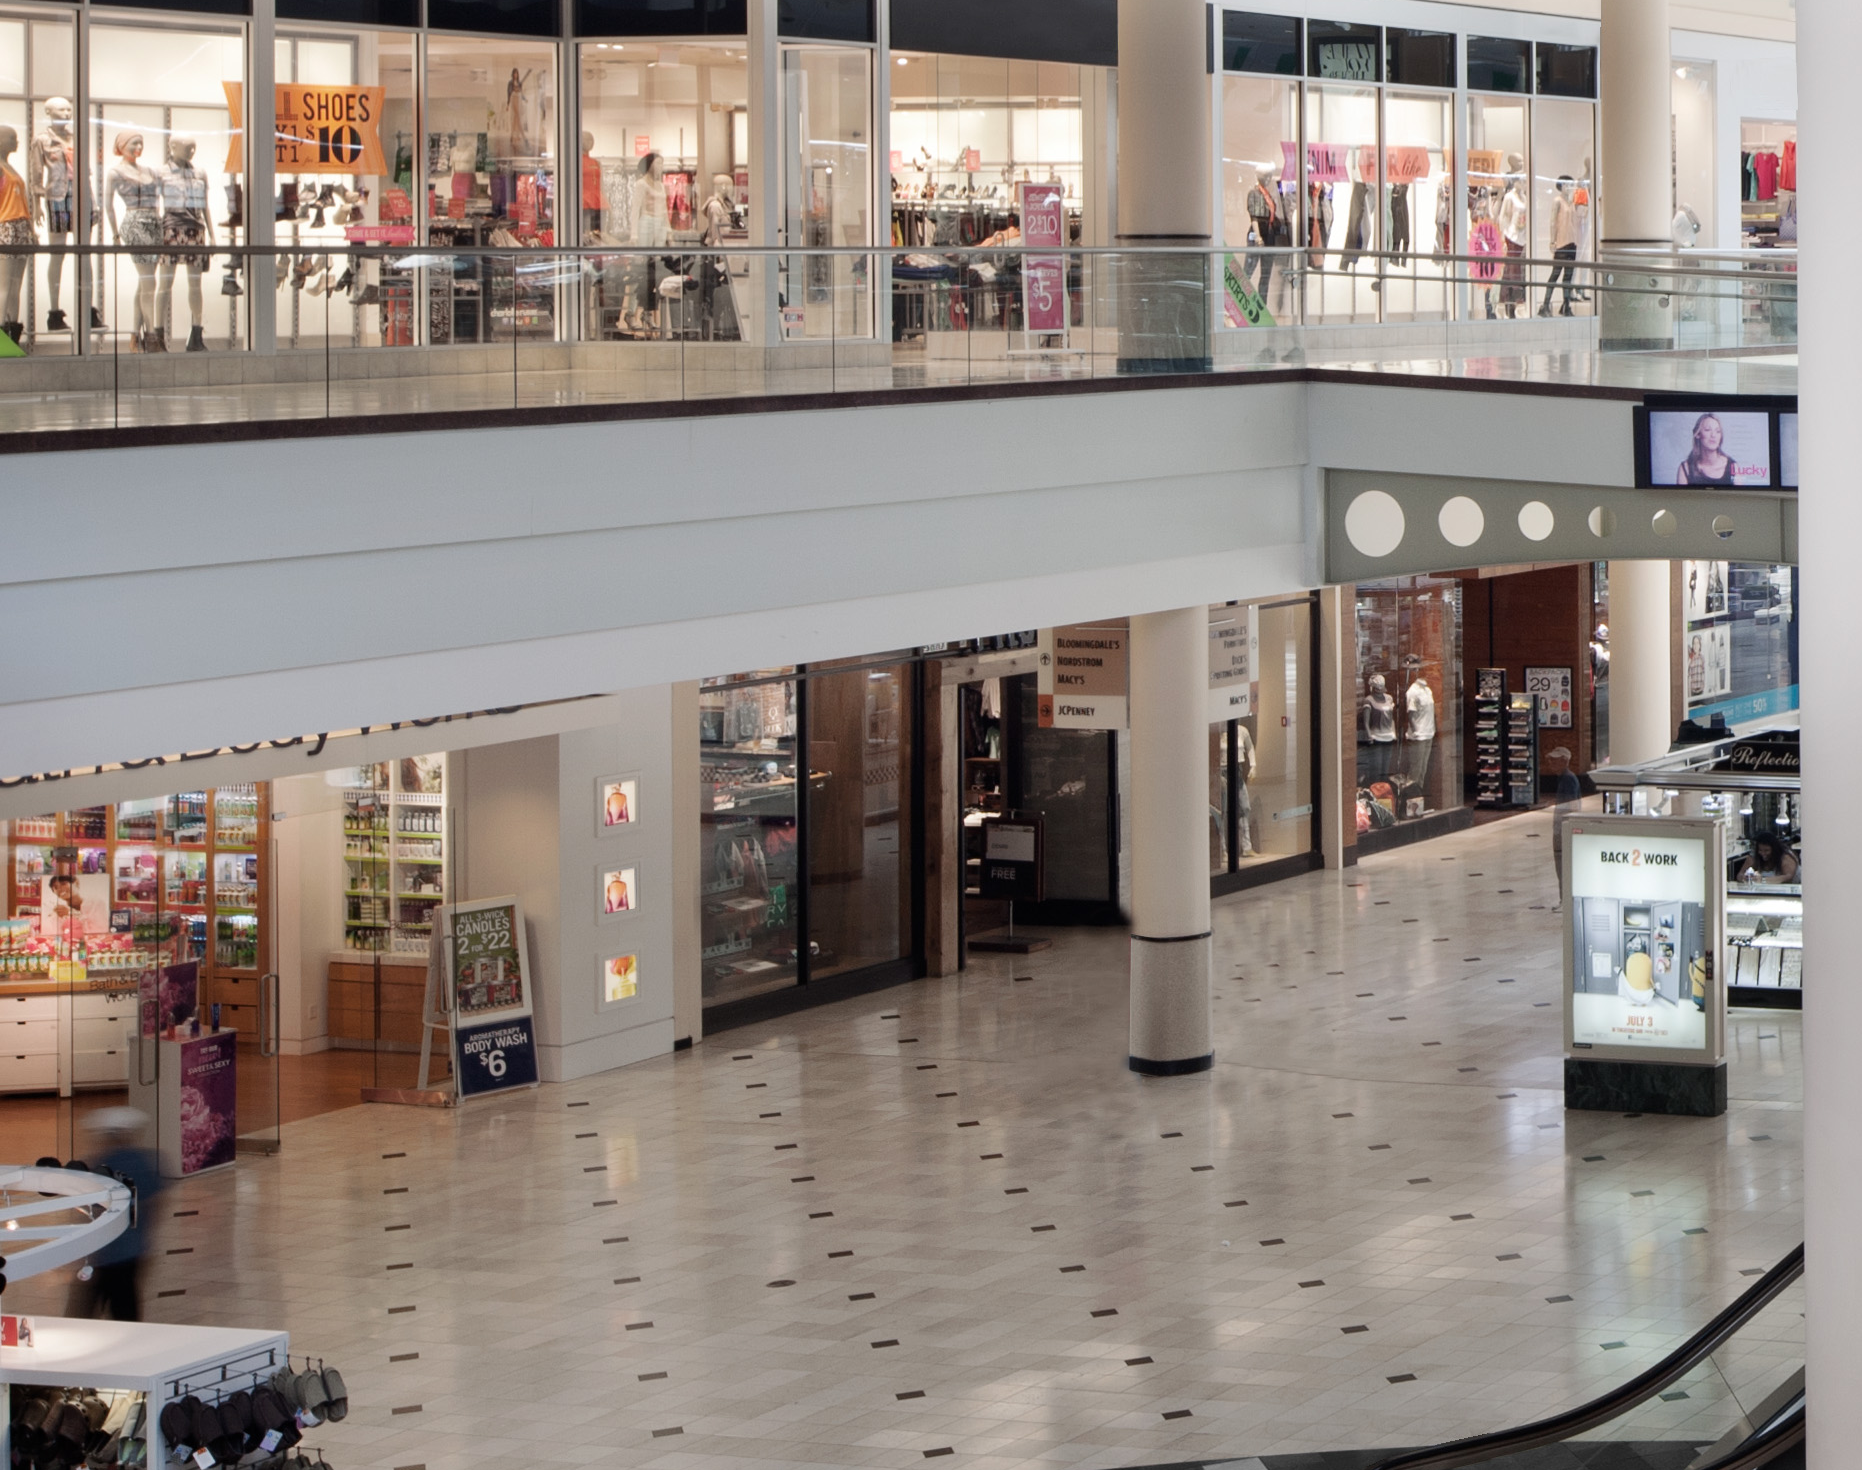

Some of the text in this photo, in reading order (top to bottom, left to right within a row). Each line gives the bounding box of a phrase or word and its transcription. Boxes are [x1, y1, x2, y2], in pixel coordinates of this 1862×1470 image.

[303, 92, 370, 122] SHOES
[1307, 150, 1337, 176] ENIM
[1366, 153, 1423, 177] FR like
[1032, 281, 1052, 311] $5
[1731, 463, 1768, 477] Lucky
[1057, 638, 1120, 649] BLOOMINGDALE'S
[1057, 656, 1103, 667] NORDSTROM
[1057, 674, 1085, 685] MACY'S
[1229, 694, 1248, 706] MACY'S
[1731, 746, 1799, 770] Reflectio
[1600, 849, 1678, 867] BACK 2 WORK
[991, 869, 1016, 880] FREE
[459, 909, 506, 925] ALL 3-WICK
[456, 917, 510, 937] CANDLES
[458, 931, 511, 955] 2 FOR $22
[90, 977, 118, 991] Bath
[1626, 1015, 1653, 1027] JULY 3
[469, 1026, 521, 1042] AROMATHERAPY
[464, 1032, 528, 1054] BODY WASH
[214, 1059, 231, 1070] SEXY
[479, 1050, 507, 1077] $6
